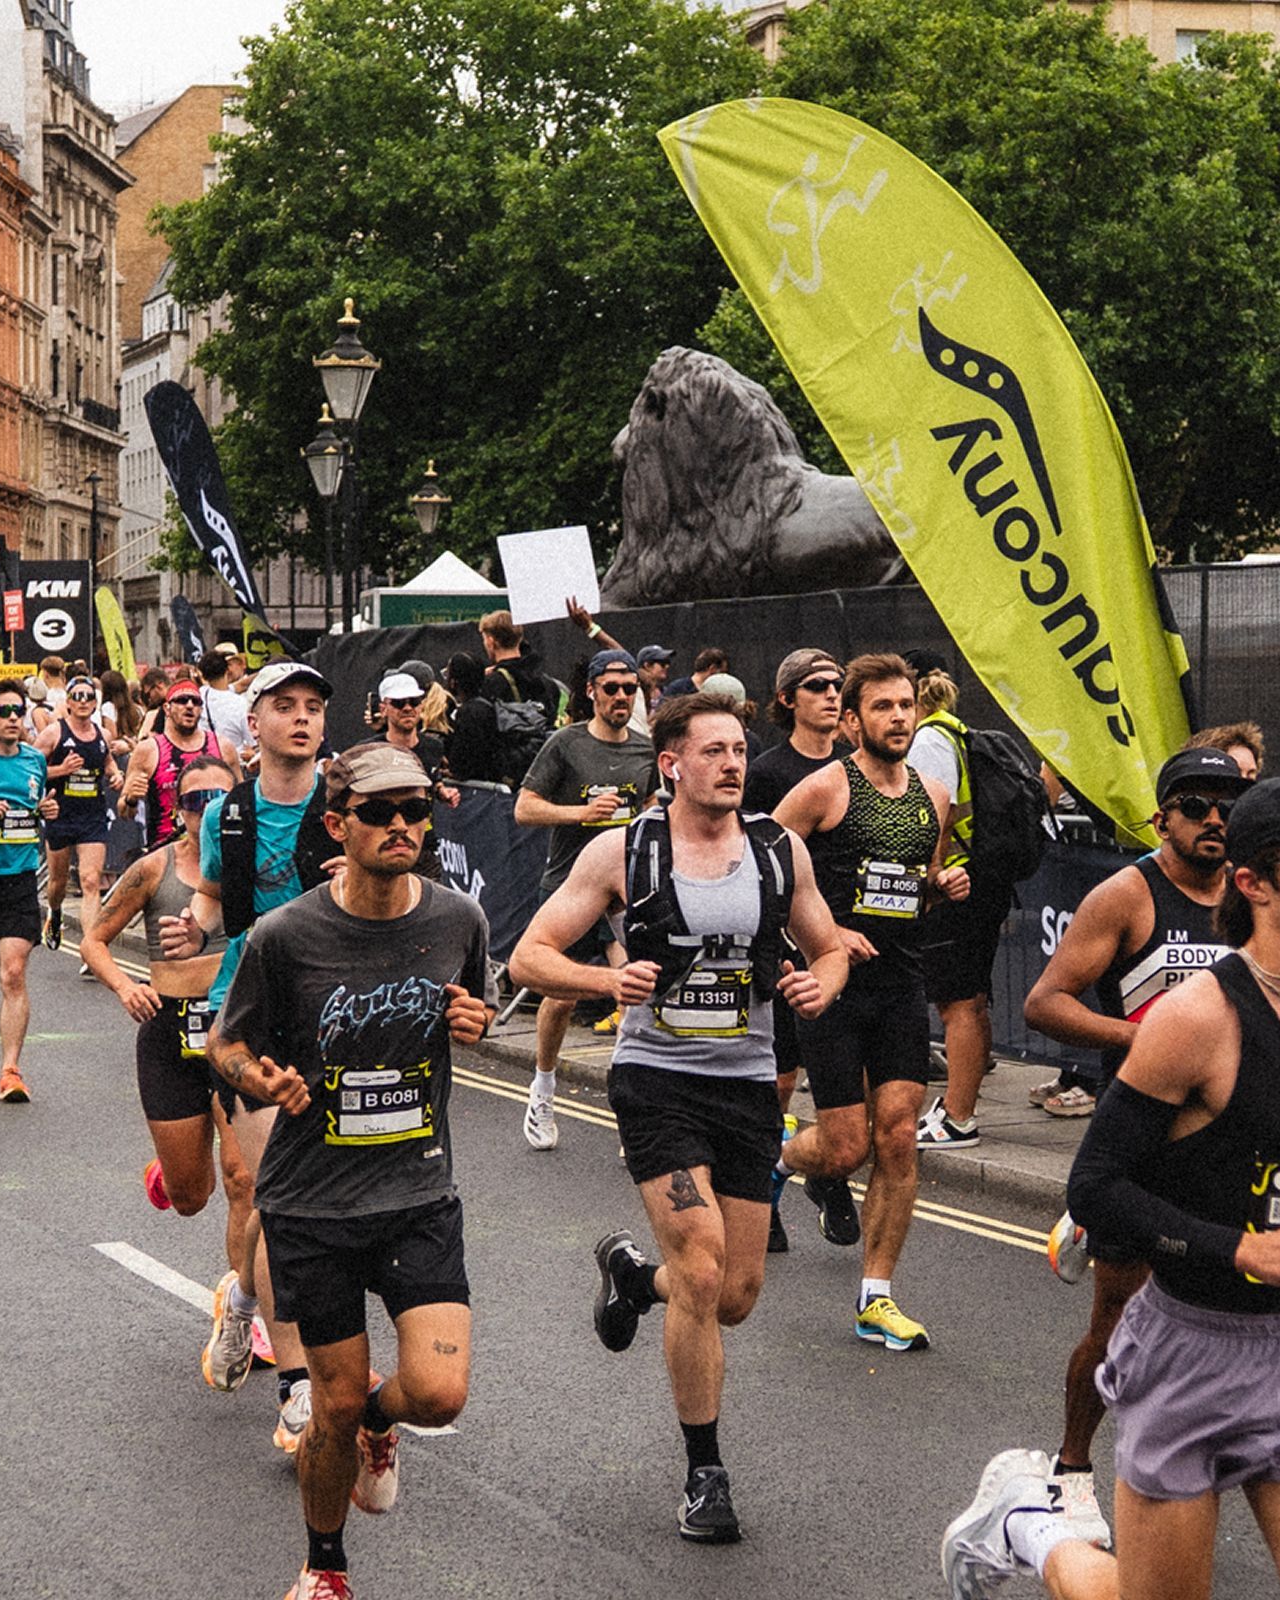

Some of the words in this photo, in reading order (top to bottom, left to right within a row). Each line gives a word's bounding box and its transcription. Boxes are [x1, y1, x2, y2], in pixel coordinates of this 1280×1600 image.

[26, 580, 81, 598] KM
[930, 416, 1135, 746] saucony
[40, 619, 67, 638] 3
[881, 879, 891, 889] B
[892, 879, 919, 892] 4056
[871, 895, 908, 908] MAX
[1166, 930, 1188, 943] LM
[1166, 949, 1218, 965] BODY
[684, 992, 695, 1004] B
[698, 991, 735, 1004] 13131
[365, 1093, 379, 1108] B
[381, 1089, 420, 1106] 6081
